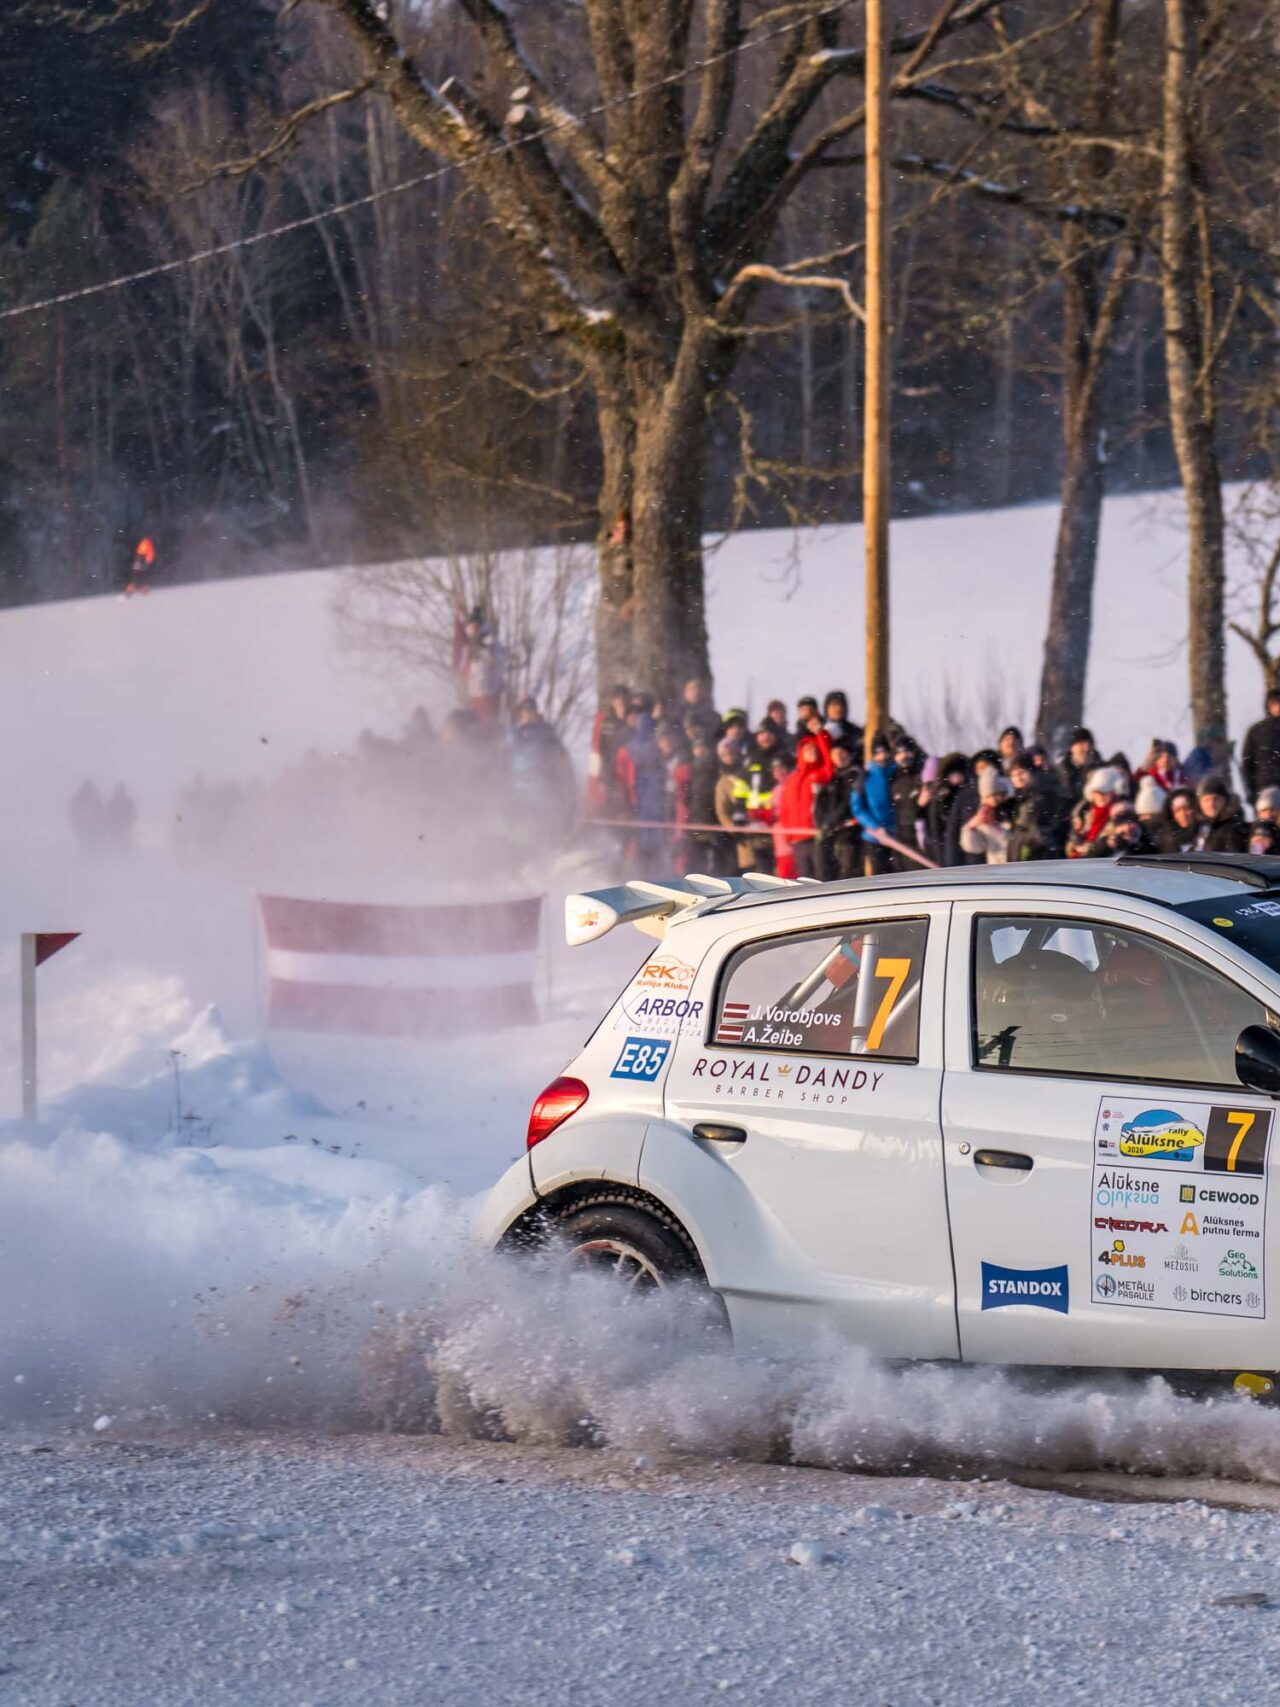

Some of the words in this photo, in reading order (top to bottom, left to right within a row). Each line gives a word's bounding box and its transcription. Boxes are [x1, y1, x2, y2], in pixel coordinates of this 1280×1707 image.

[663, 981, 689, 991] Klubs
[635, 998, 704, 1019] ARBOR
[866, 958, 912, 1050] 7
[750, 1004, 842, 1028] J.Vorobjovs
[744, 1024, 803, 1045] A.Žeibe
[614, 1043, 667, 1076] E85
[692, 1058, 770, 1082] ROYAL
[795, 1065, 886, 1093] DANDY
[715, 1084, 784, 1099] BARBER
[801, 1092, 848, 1105] SHOP
[1168, 1128, 1189, 1136] rally
[1124, 1133, 1185, 1149] Alūksne
[1227, 1111, 1256, 1171] 7
[1127, 1146, 1144, 1154] 2026
[1098, 1171, 1160, 1193] Alūksne
[1199, 1190, 1260, 1206] CEWOOD
[1203, 1215, 1245, 1227] Alūksnes
[1203, 1226, 1230, 1235] putnu
[1232, 1227, 1260, 1238] ferma
[1219, 1268, 1258, 1279] Solutions
[989, 1279, 1062, 1296] STANDOX
[1118, 1290, 1155, 1301] PASAULE
[1190, 1288, 1242, 1305] birchers
